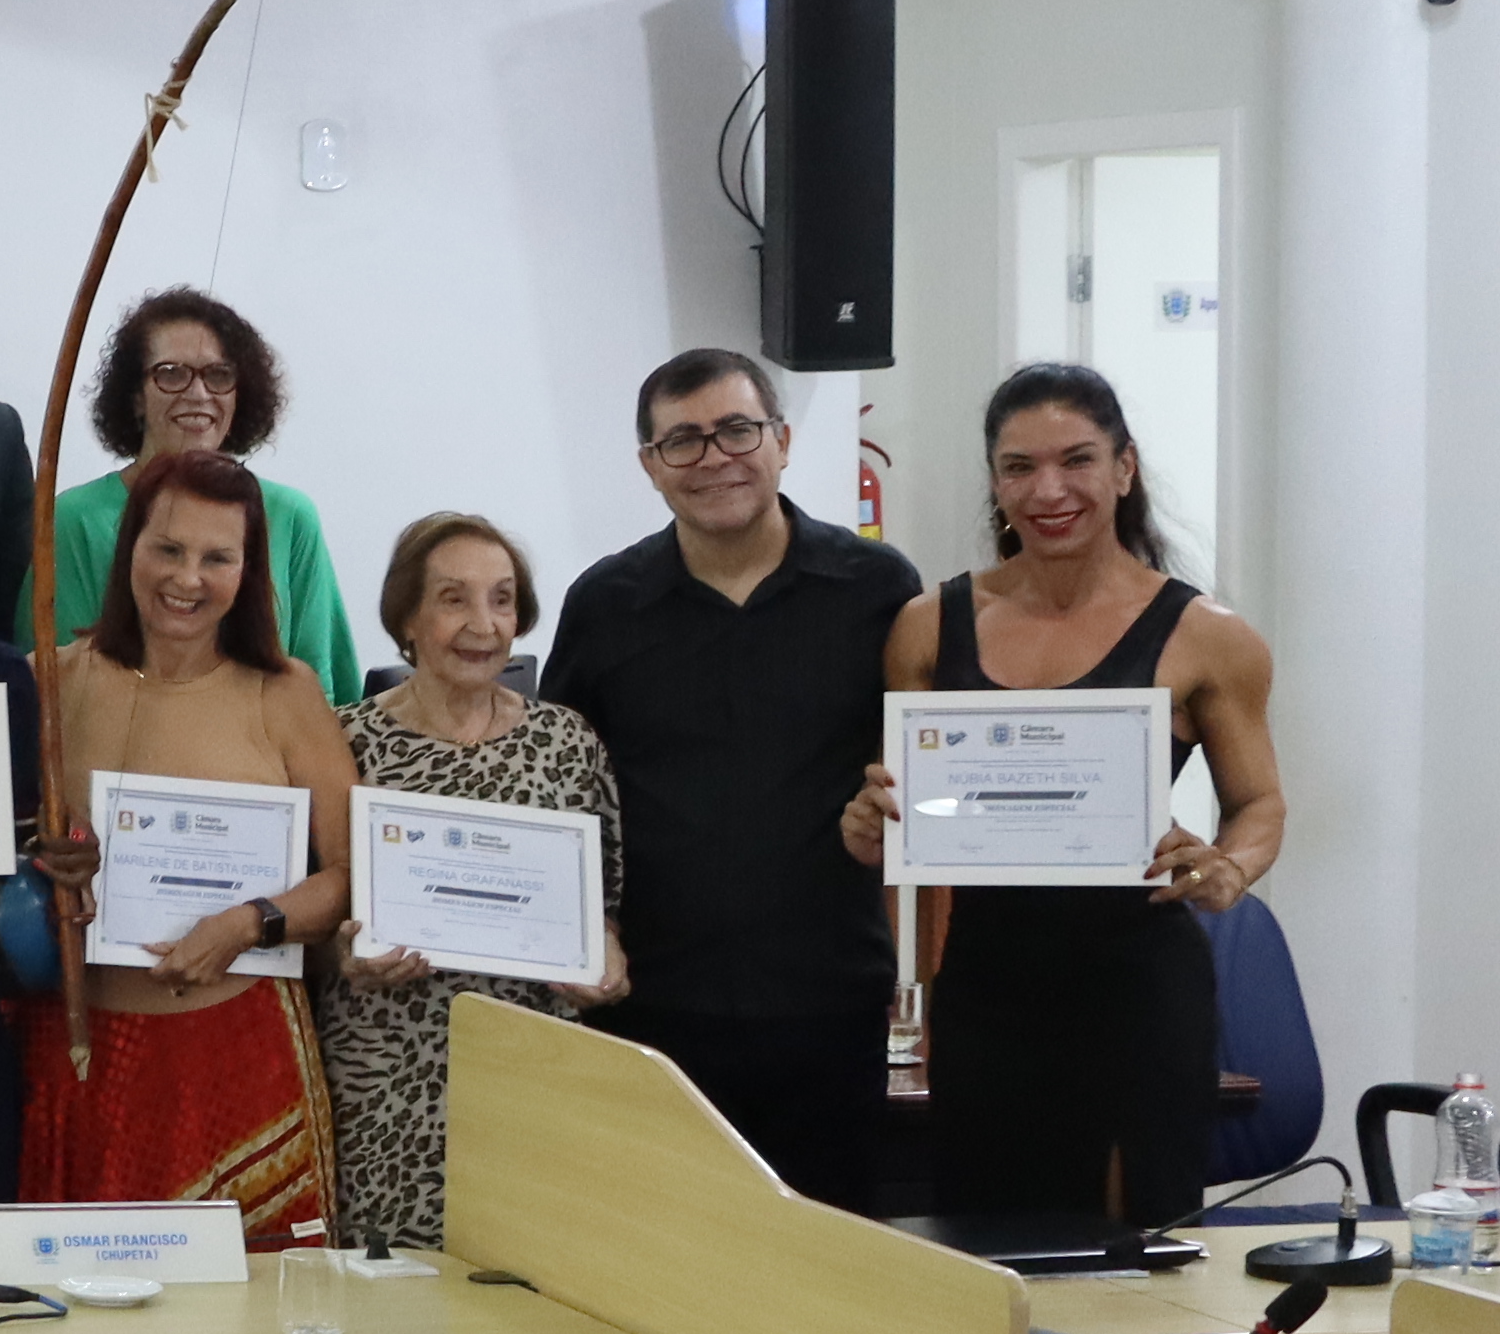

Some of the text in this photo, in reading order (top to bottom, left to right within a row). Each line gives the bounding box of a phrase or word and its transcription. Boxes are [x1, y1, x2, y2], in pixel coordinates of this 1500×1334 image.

[1020, 724, 1055, 732] Câmara
[1020, 732, 1064, 741] Municipal
[1060, 771, 1102, 783] SILVA
[173, 858, 190, 870] DE
[192, 860, 239, 875] BATISTA
[408, 866, 458, 881] REGINA
[63, 1233, 188, 1247] OSMAR FRANCISCO
[95, 1250, 159, 1261] (CHUPETA)
